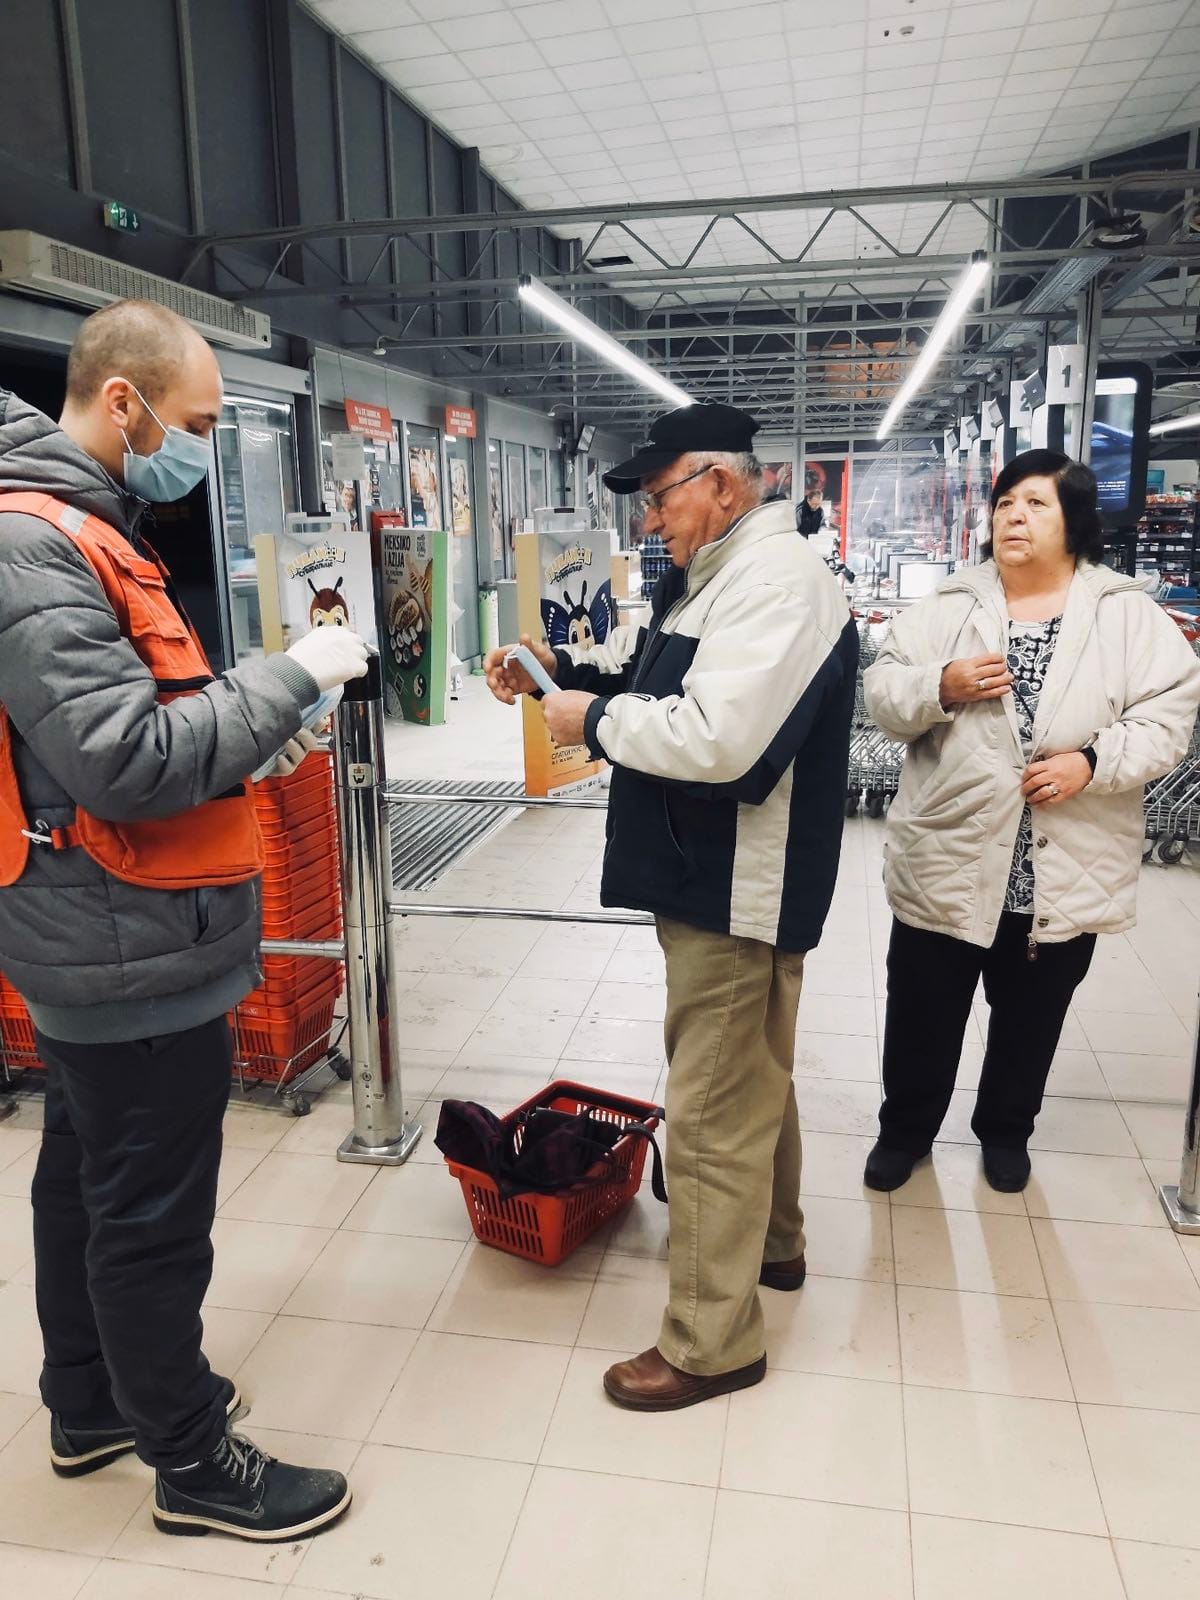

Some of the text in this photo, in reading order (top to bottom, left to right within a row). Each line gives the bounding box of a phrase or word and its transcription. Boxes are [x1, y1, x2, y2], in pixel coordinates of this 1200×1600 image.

[1062, 365, 1071, 388] 1
[384, 535, 410, 551] MEKSIKO
[384, 551, 405, 568] I AZIJA
